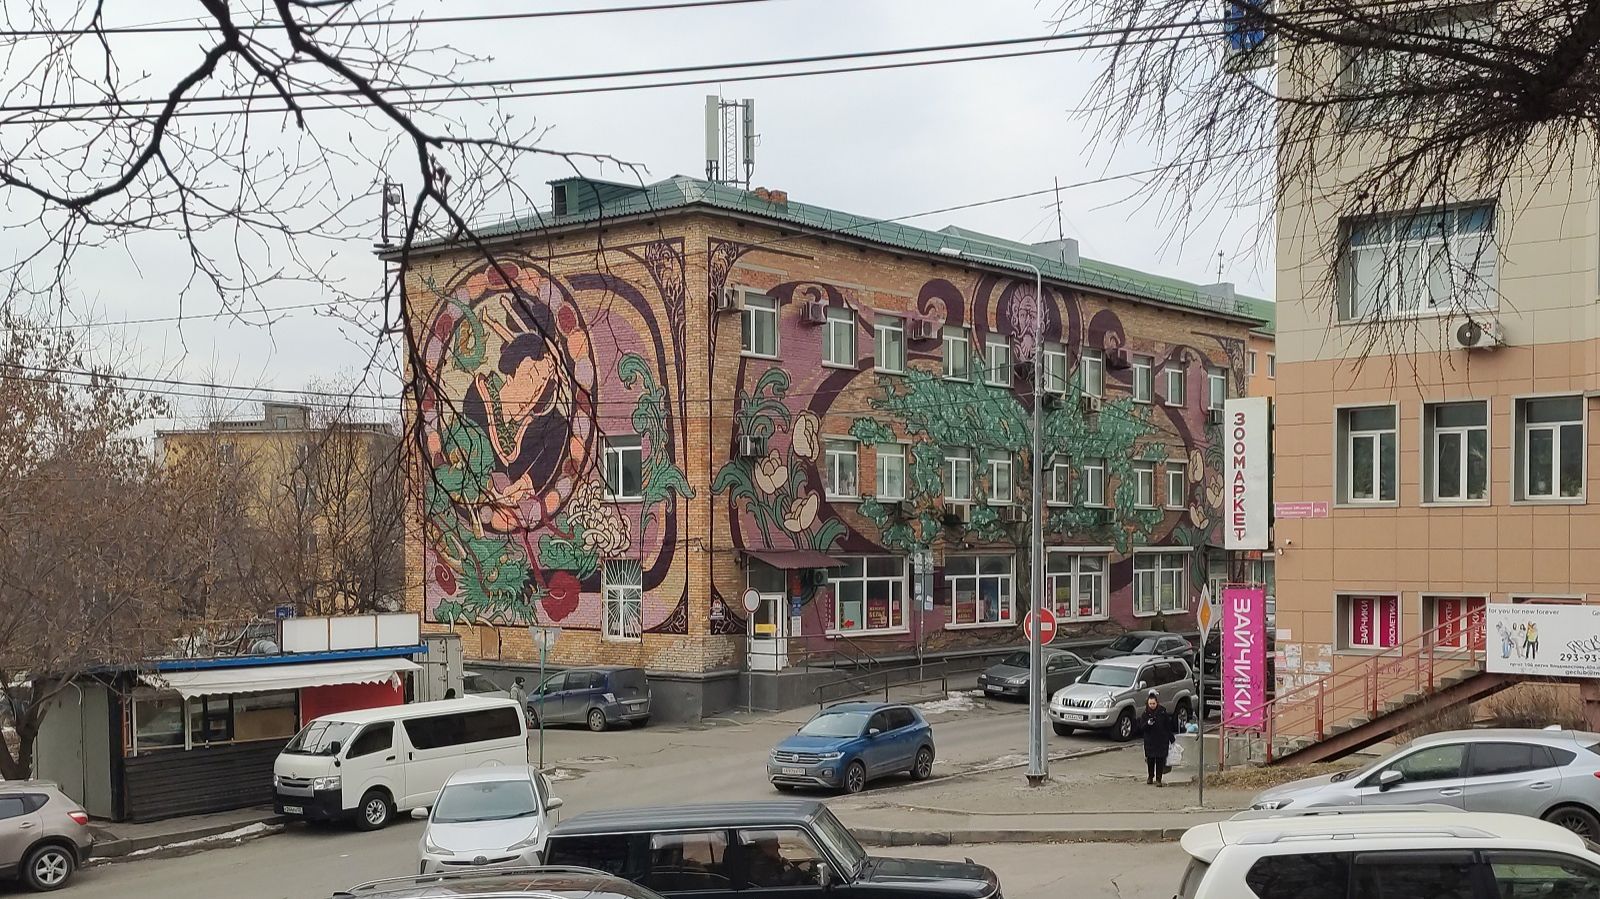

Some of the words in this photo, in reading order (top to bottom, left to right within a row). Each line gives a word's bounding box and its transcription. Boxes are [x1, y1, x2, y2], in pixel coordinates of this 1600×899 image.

[1233, 412, 1246, 541] ЗООМАРКЕТ
[1359, 600, 1369, 644] ЗАЙЧИКИ
[1388, 599, 1397, 647] КОСМЕТИКА
[1498, 608, 1511, 616] you
[1233, 598, 1255, 718] ЗАЙЧИКИ
